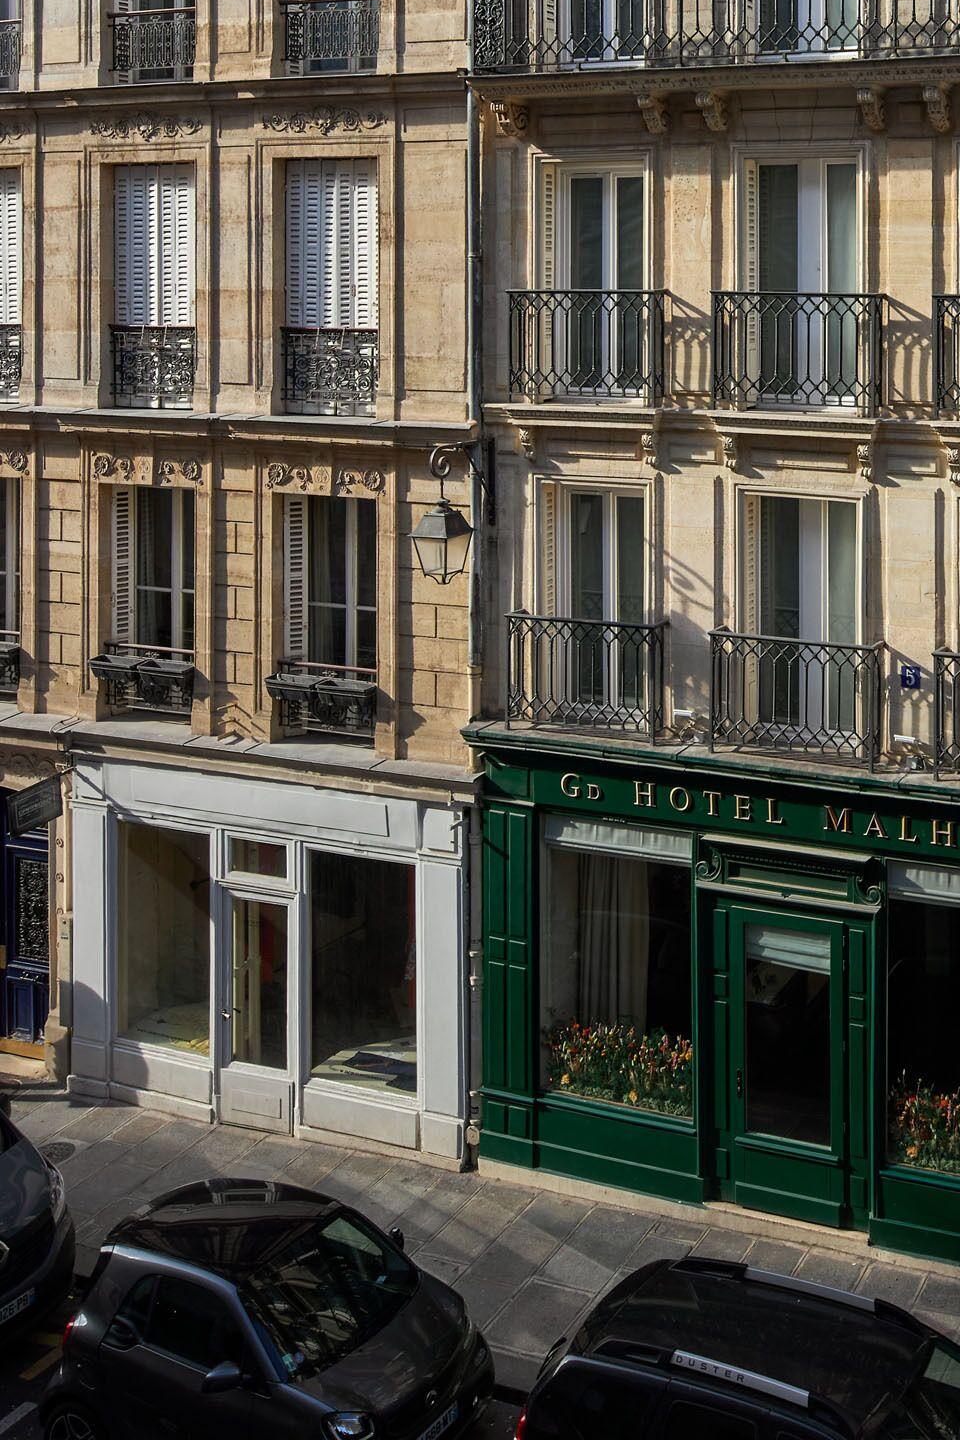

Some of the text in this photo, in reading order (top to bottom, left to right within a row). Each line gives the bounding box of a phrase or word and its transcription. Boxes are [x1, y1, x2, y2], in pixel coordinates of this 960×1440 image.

[905, 668, 916, 686] 5
[632, 780, 784, 825] HOTEL
[675, 1355, 745, 1383] DUSTER
